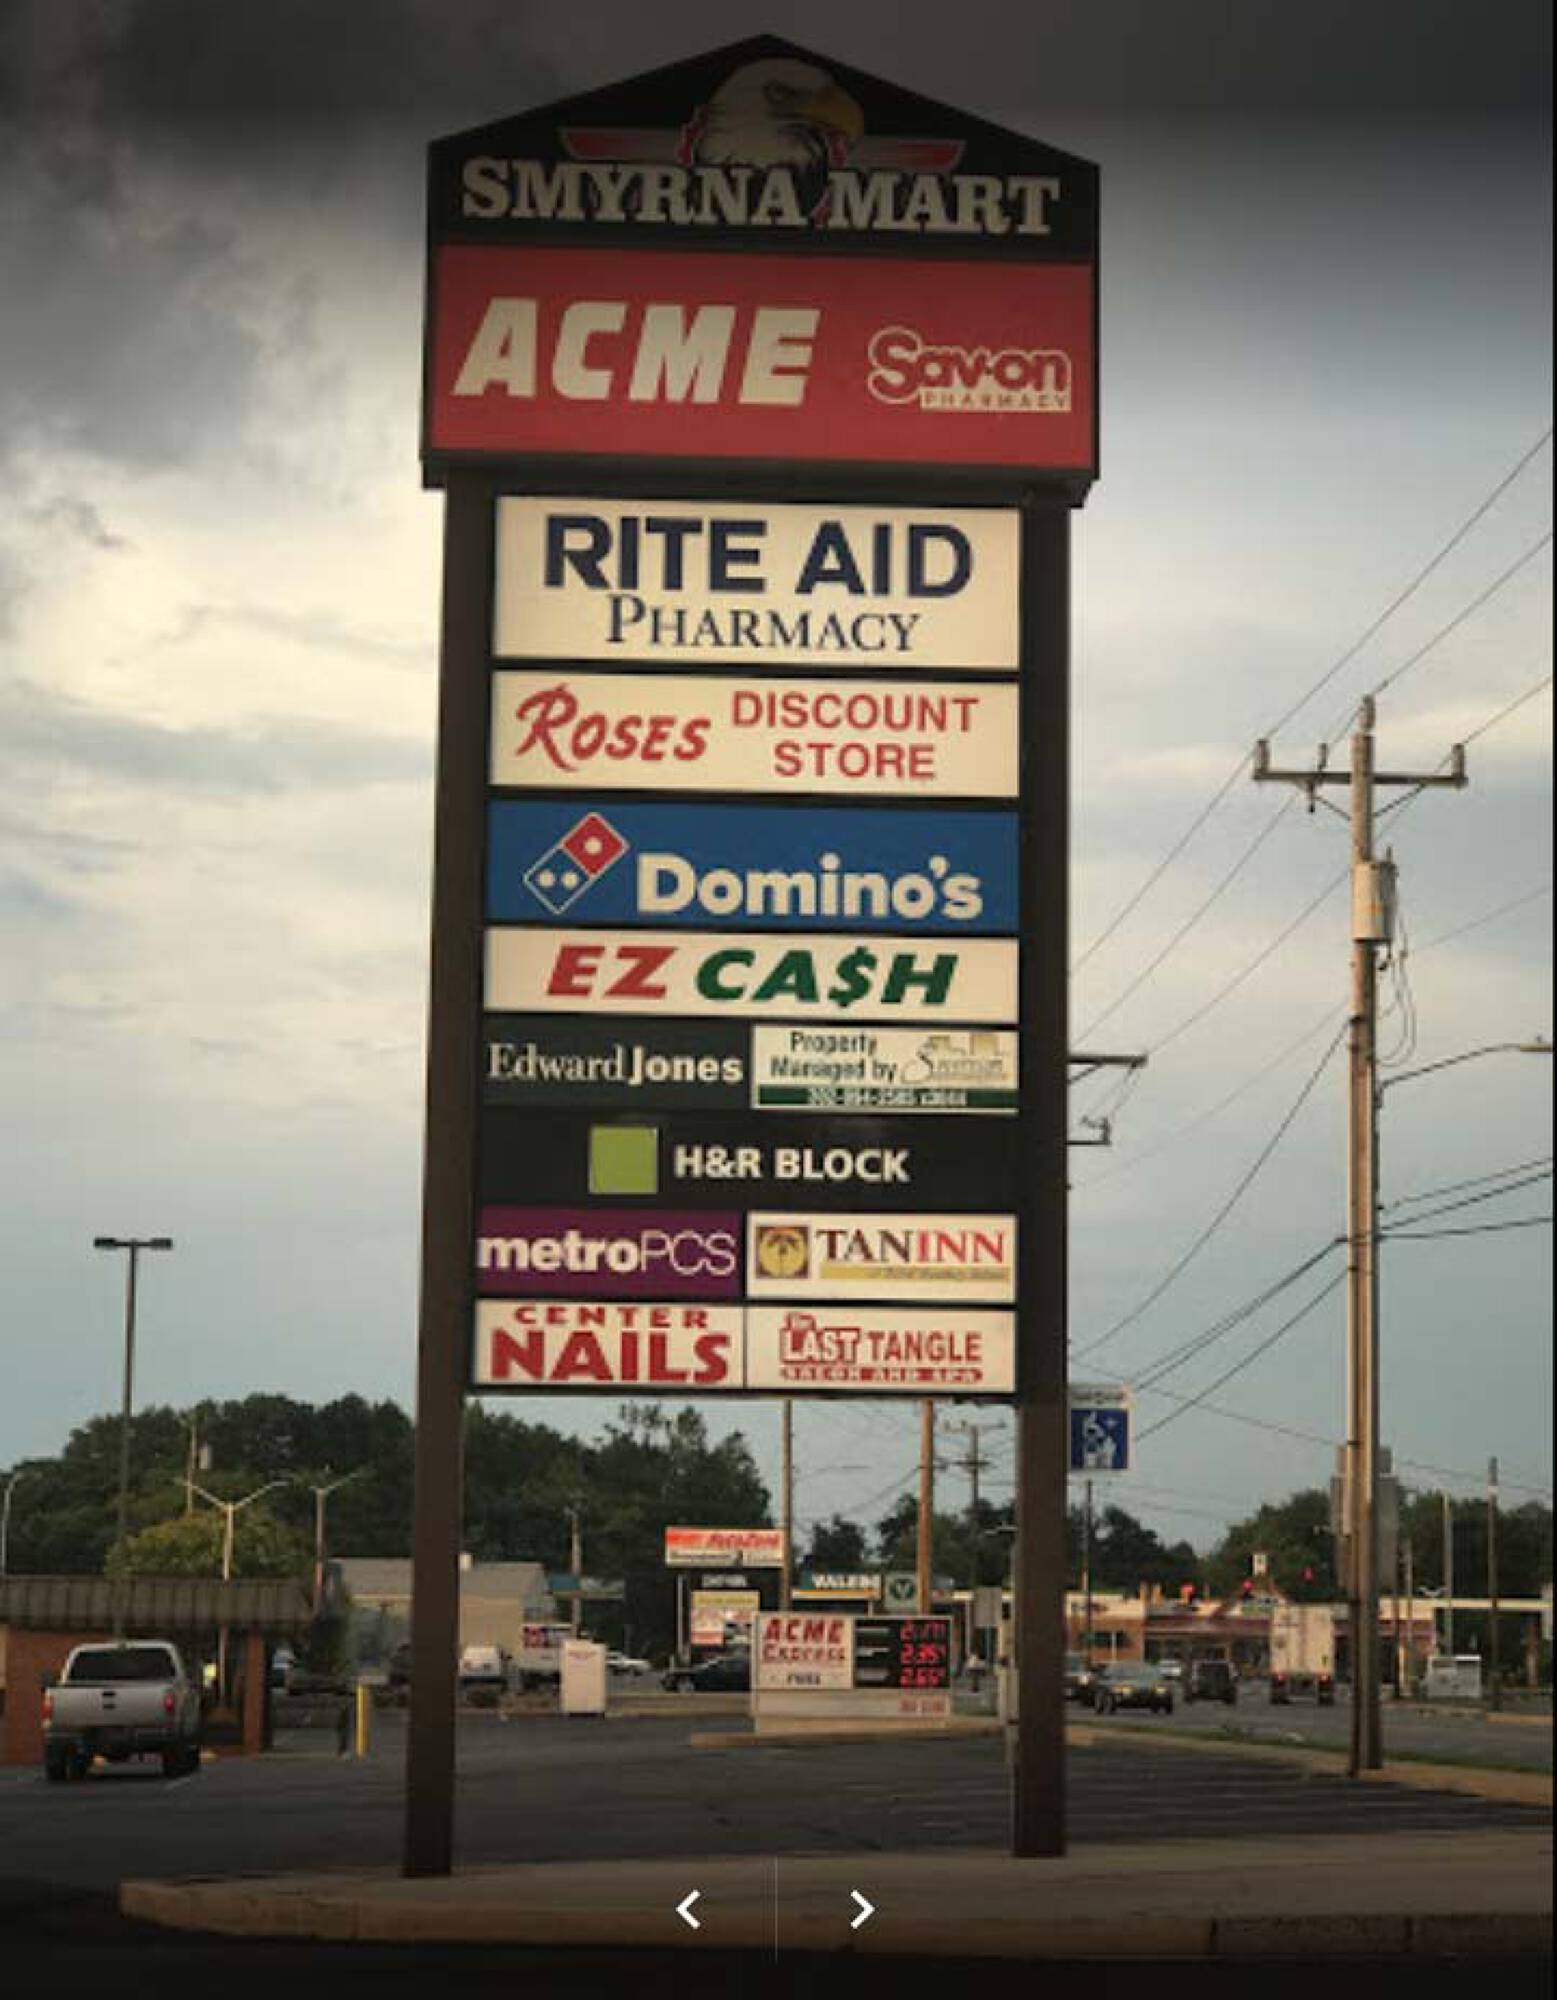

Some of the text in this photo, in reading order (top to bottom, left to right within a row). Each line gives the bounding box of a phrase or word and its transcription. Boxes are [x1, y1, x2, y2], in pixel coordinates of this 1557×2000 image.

[461, 156, 1061, 235] SMYRNA MART
[453, 297, 821, 406] ACME
[543, 514, 974, 598] RITE AID
[604, 593, 922, 652] PHARMACY
[732, 690, 980, 733] DISCOUNT
[773, 741, 936, 780] STORE
[637, 852, 983, 921] Domino's
[546, 943, 959, 1009] EZ CA$H
[790, 1031, 878, 1056] Property
[770, 1056, 866, 1080] Managed
[872, 1056, 898, 1083] by
[673, 1144, 911, 1184] H&R BLOCK
[476, 1228, 738, 1277] metroPCS
[513, 1305, 709, 1329] CENTER
[488, 1328, 733, 1384] NAILS
[780, 1327, 984, 1364] LAST TANGLE
[764, 1618, 845, 1643] ACME
